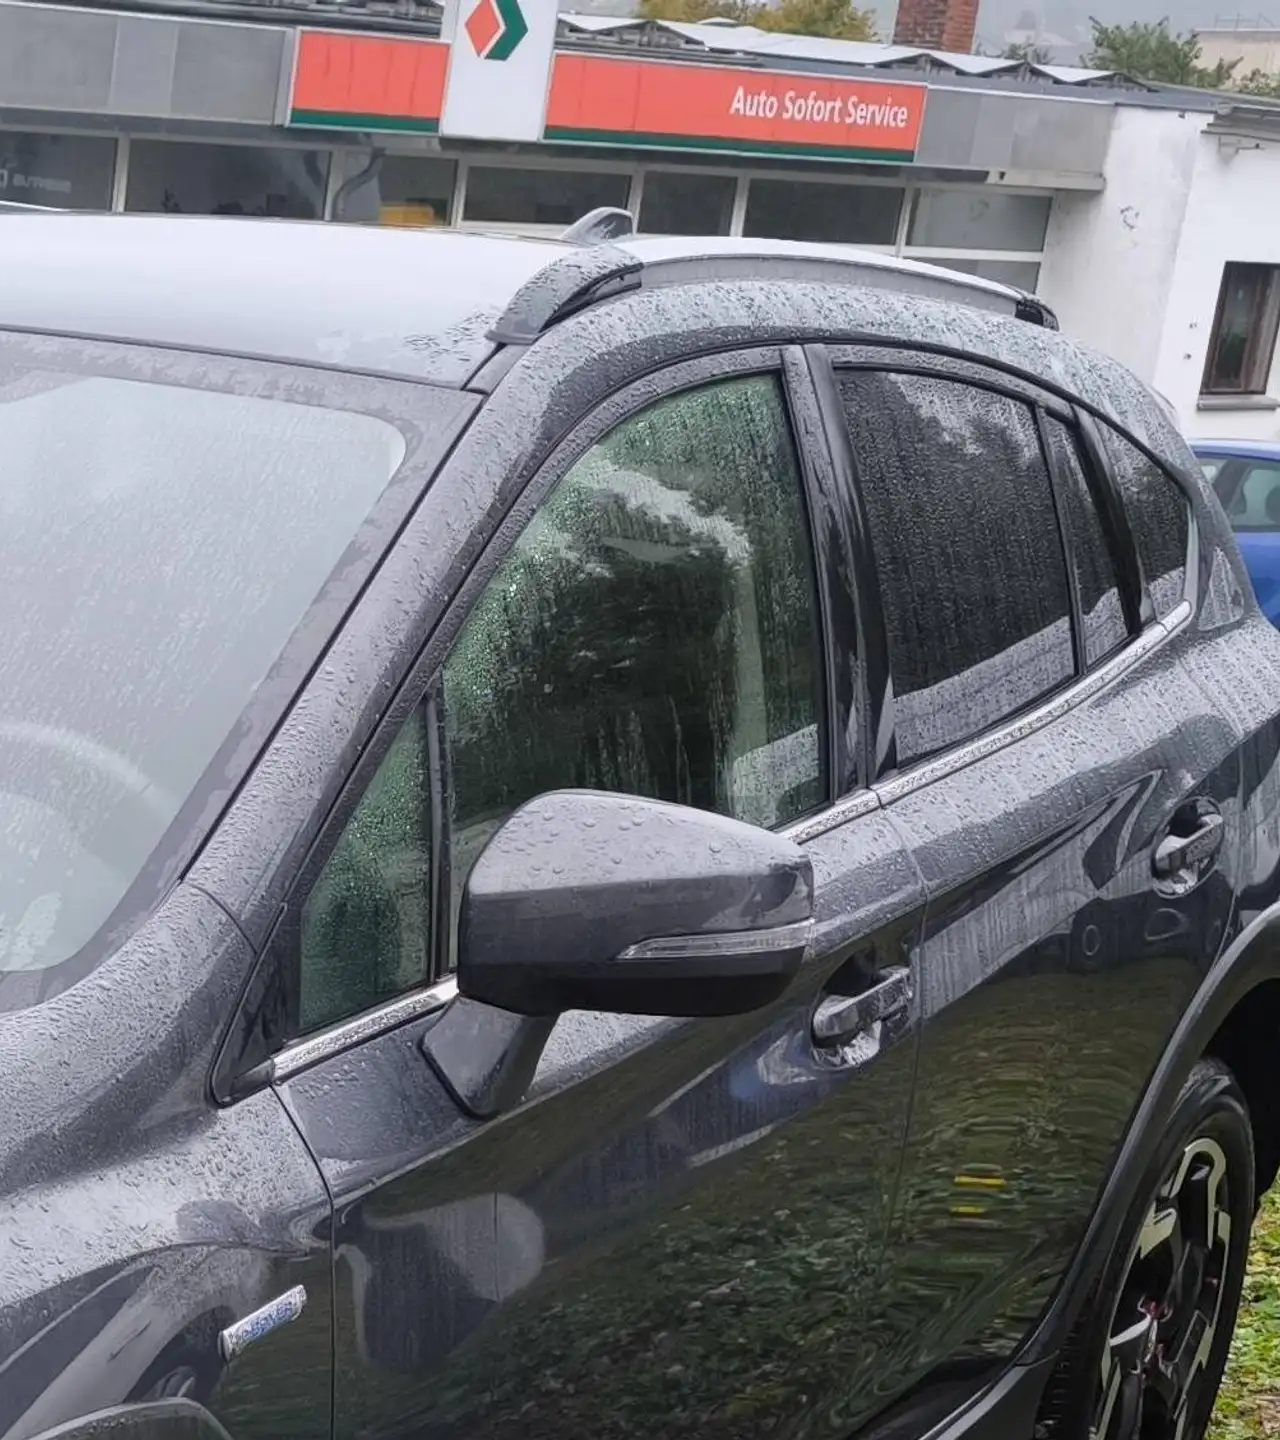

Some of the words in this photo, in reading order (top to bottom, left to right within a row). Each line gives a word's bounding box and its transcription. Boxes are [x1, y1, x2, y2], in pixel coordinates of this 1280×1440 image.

[729, 86, 778, 118] Auto
[782, 91, 841, 123] Sofort
[845, 95, 908, 128] Service
